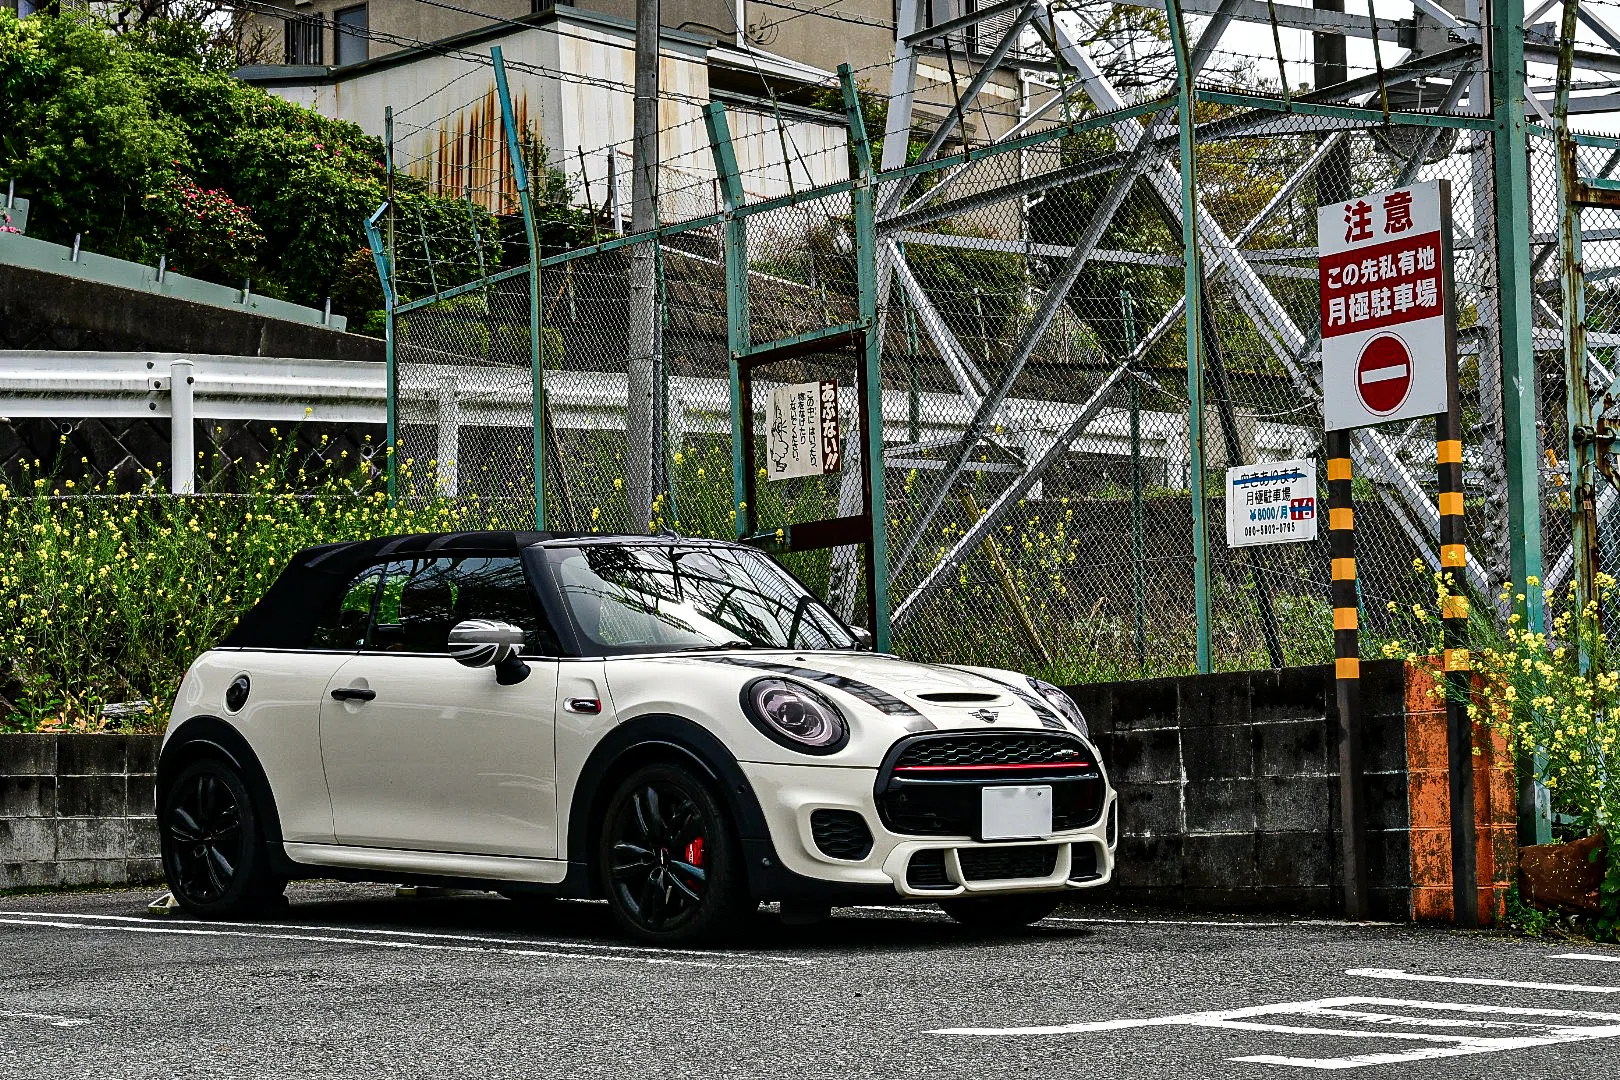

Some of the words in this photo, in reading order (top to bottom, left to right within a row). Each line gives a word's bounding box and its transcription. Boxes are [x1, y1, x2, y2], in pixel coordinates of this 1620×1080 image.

[1344, 190, 1414, 244] 注意
[1327, 245, 1435, 290] この先私有地
[1327, 277, 1438, 328] 月極駐車場
[1246, 487, 1291, 505] 月極駐車場
